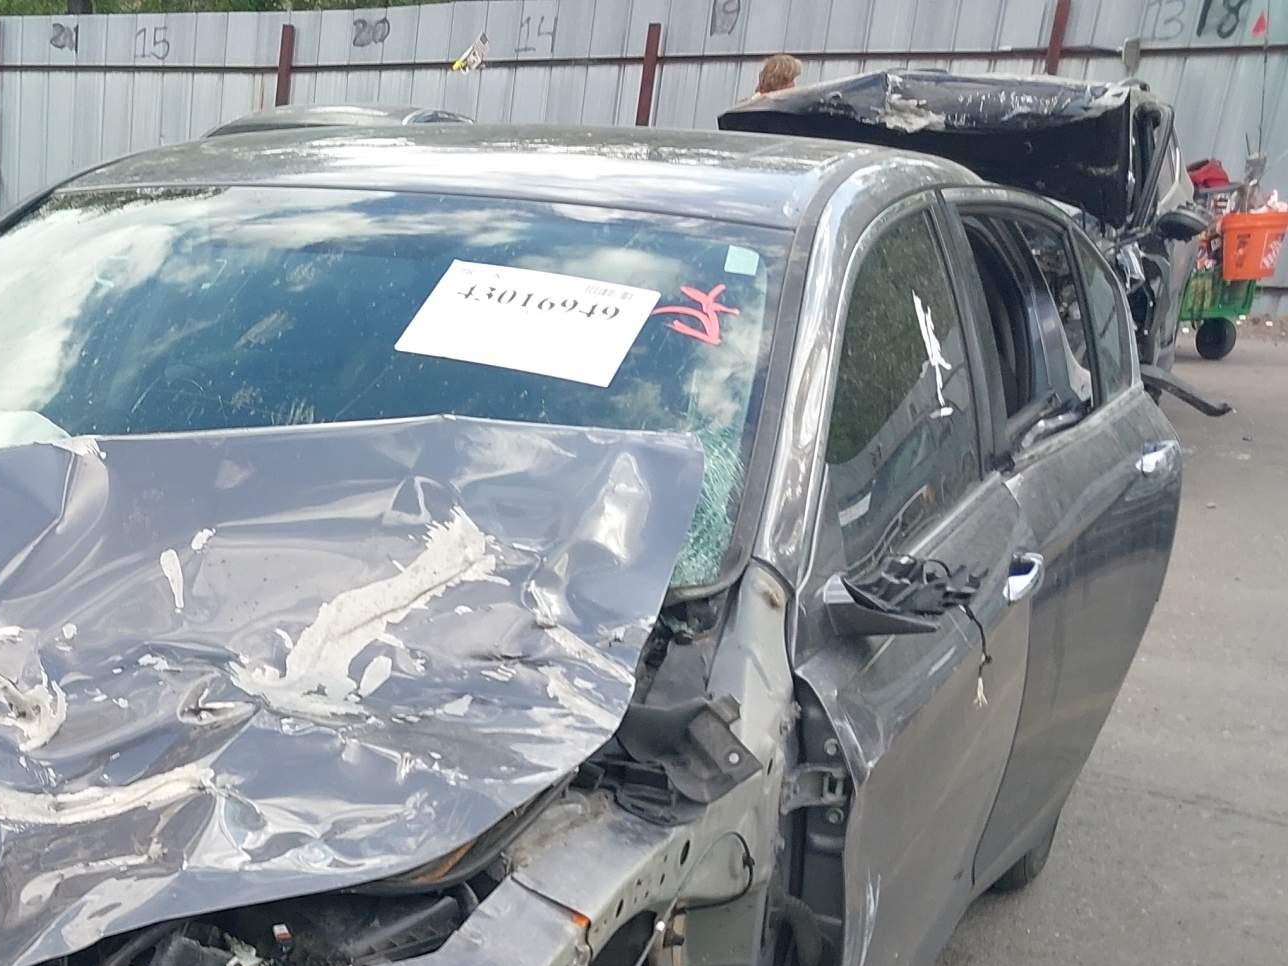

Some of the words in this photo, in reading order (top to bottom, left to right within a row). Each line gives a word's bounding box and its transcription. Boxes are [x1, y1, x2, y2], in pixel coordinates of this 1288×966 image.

[134, 26, 170, 60] 15
[515, 16, 558, 53] 14
[456, 284, 621, 320] 43016949
